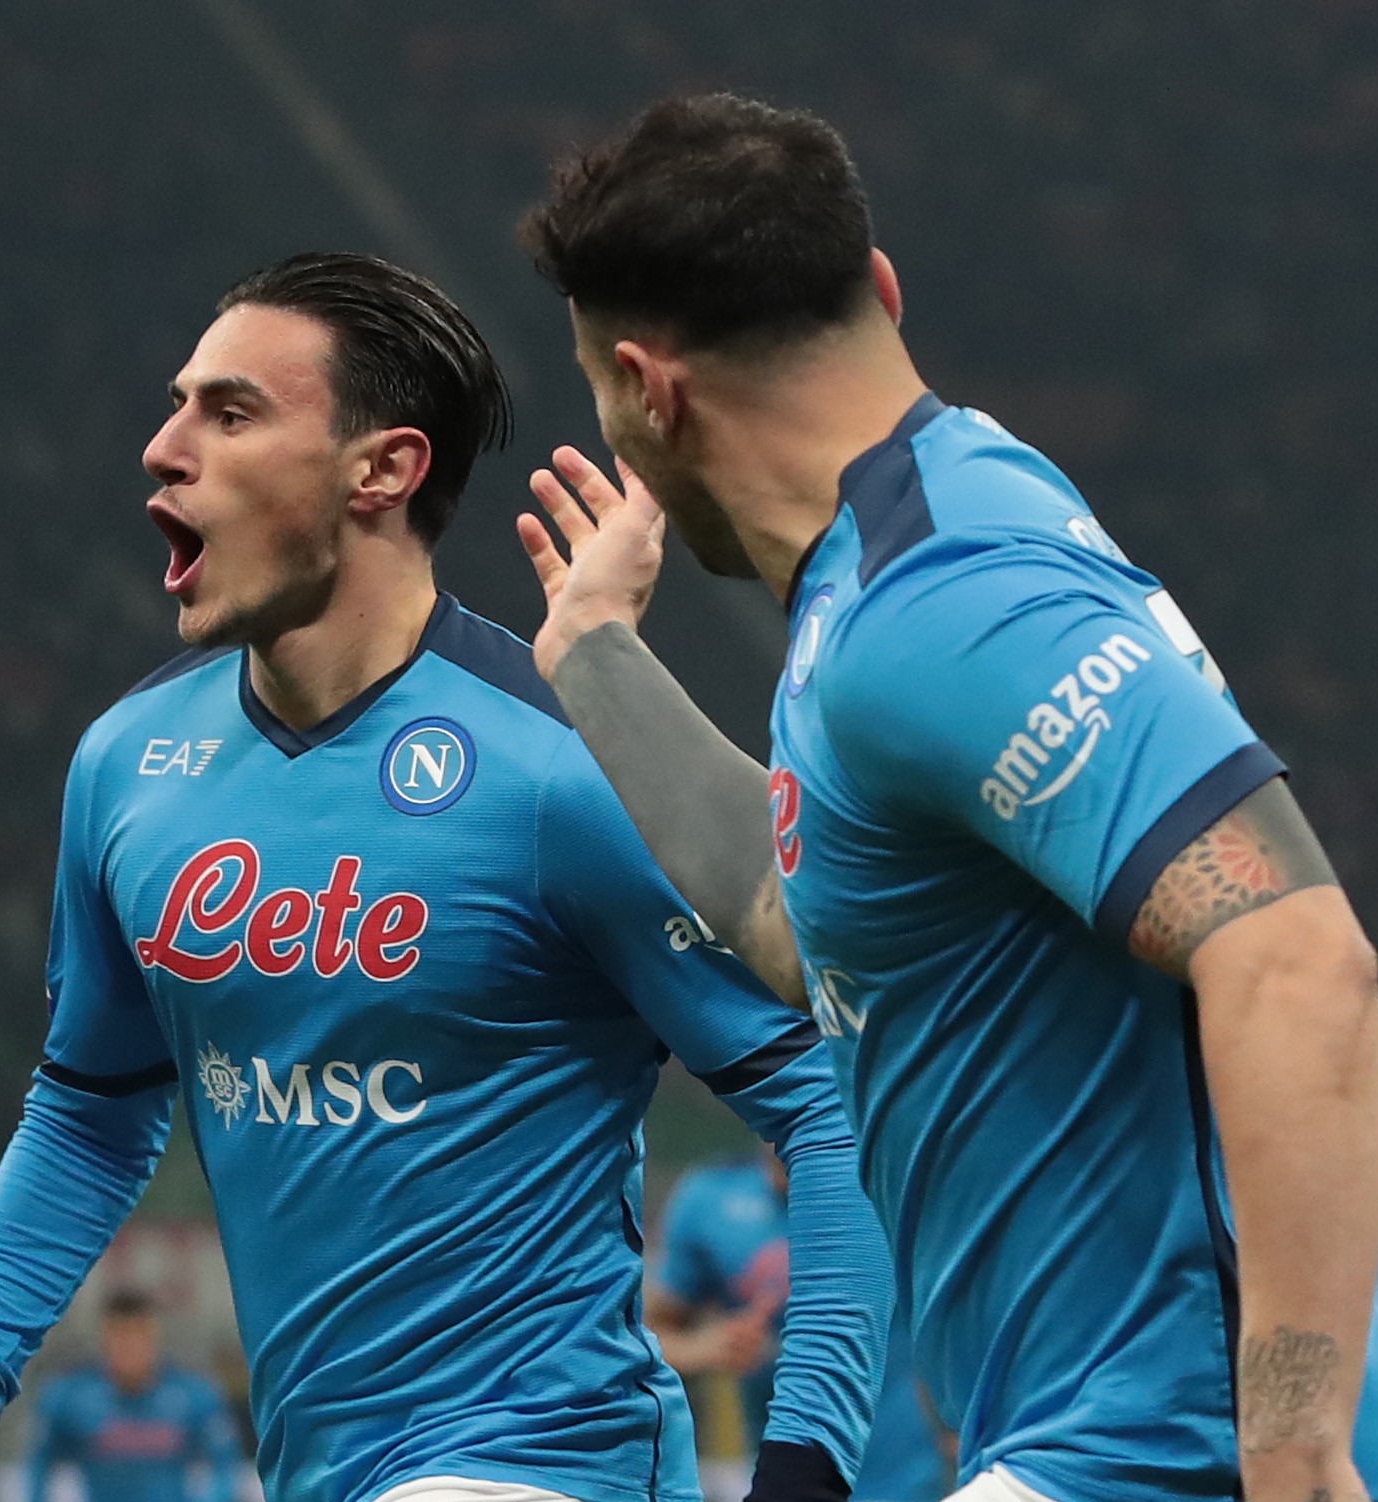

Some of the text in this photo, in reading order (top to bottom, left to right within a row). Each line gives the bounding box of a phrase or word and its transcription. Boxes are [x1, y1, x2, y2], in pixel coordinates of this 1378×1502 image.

[138, 738, 224, 776] EA7
[980, 633, 1152, 821] amazon
[404, 744, 453, 789] N
[134, 839, 429, 983] Lete
[251, 1056, 428, 1127] MSC
